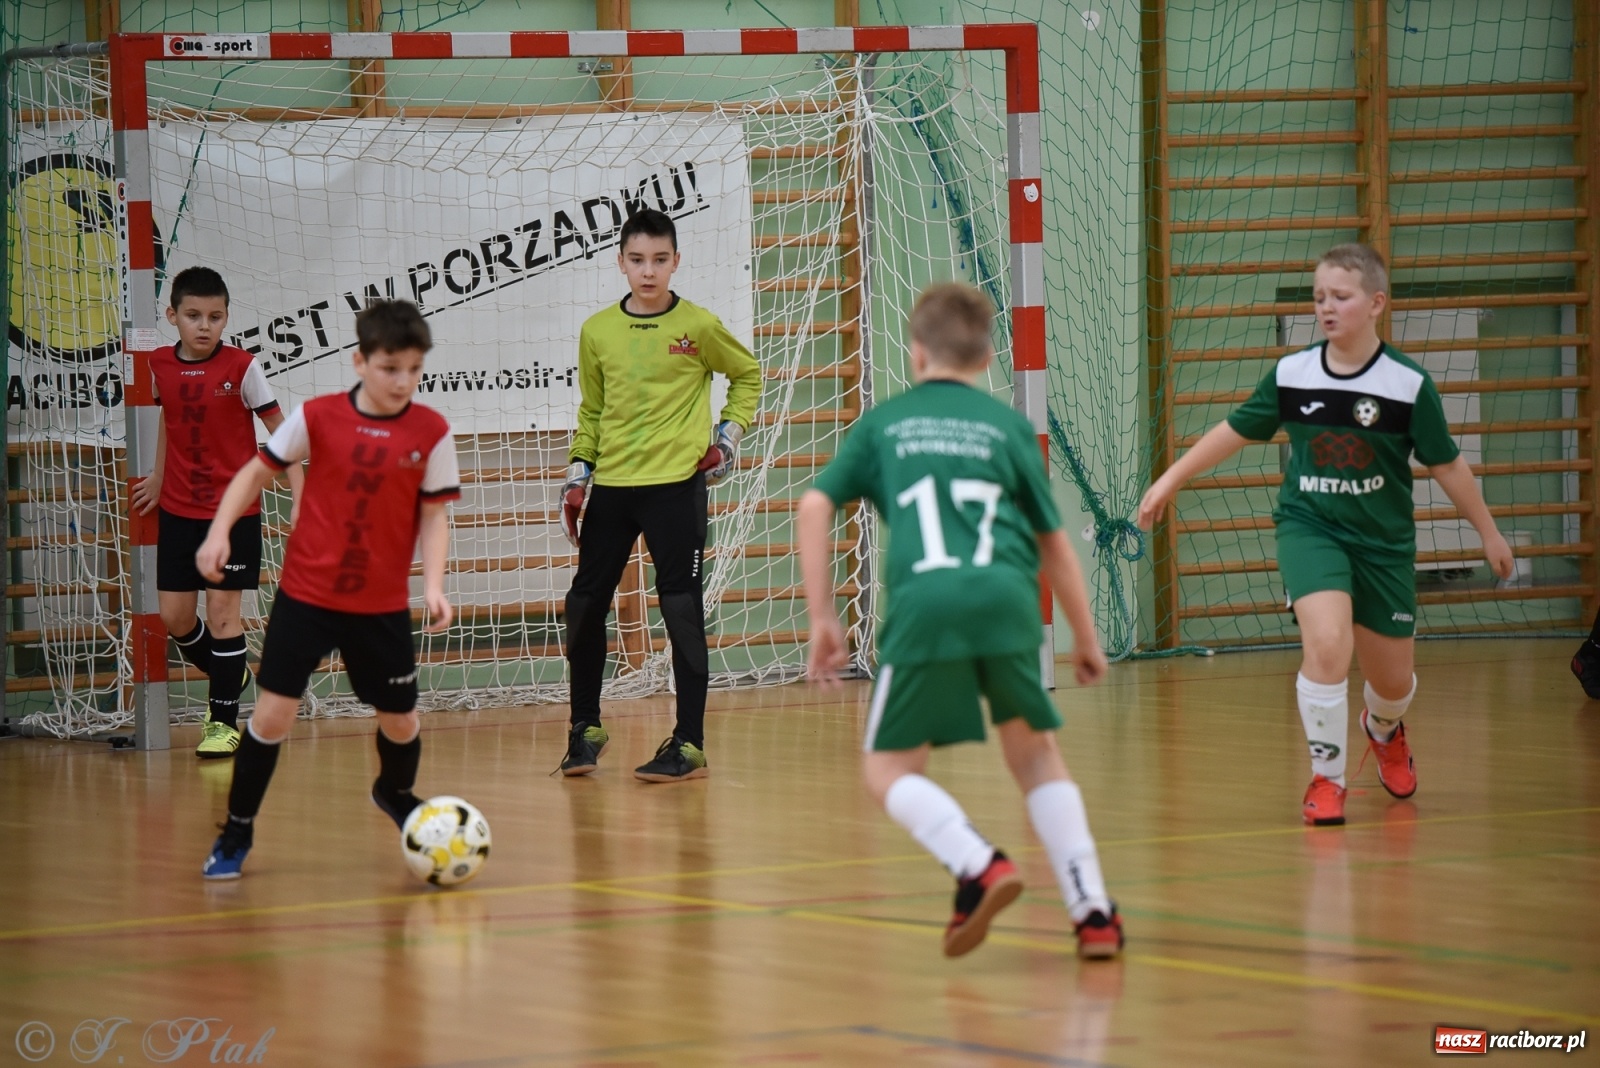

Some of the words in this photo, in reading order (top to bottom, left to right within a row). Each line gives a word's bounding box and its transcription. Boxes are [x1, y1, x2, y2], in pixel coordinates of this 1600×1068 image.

[214, 40, 253, 54] sport
[1299, 475, 1384, 496] METALIO
[895, 473, 1003, 574] 17
